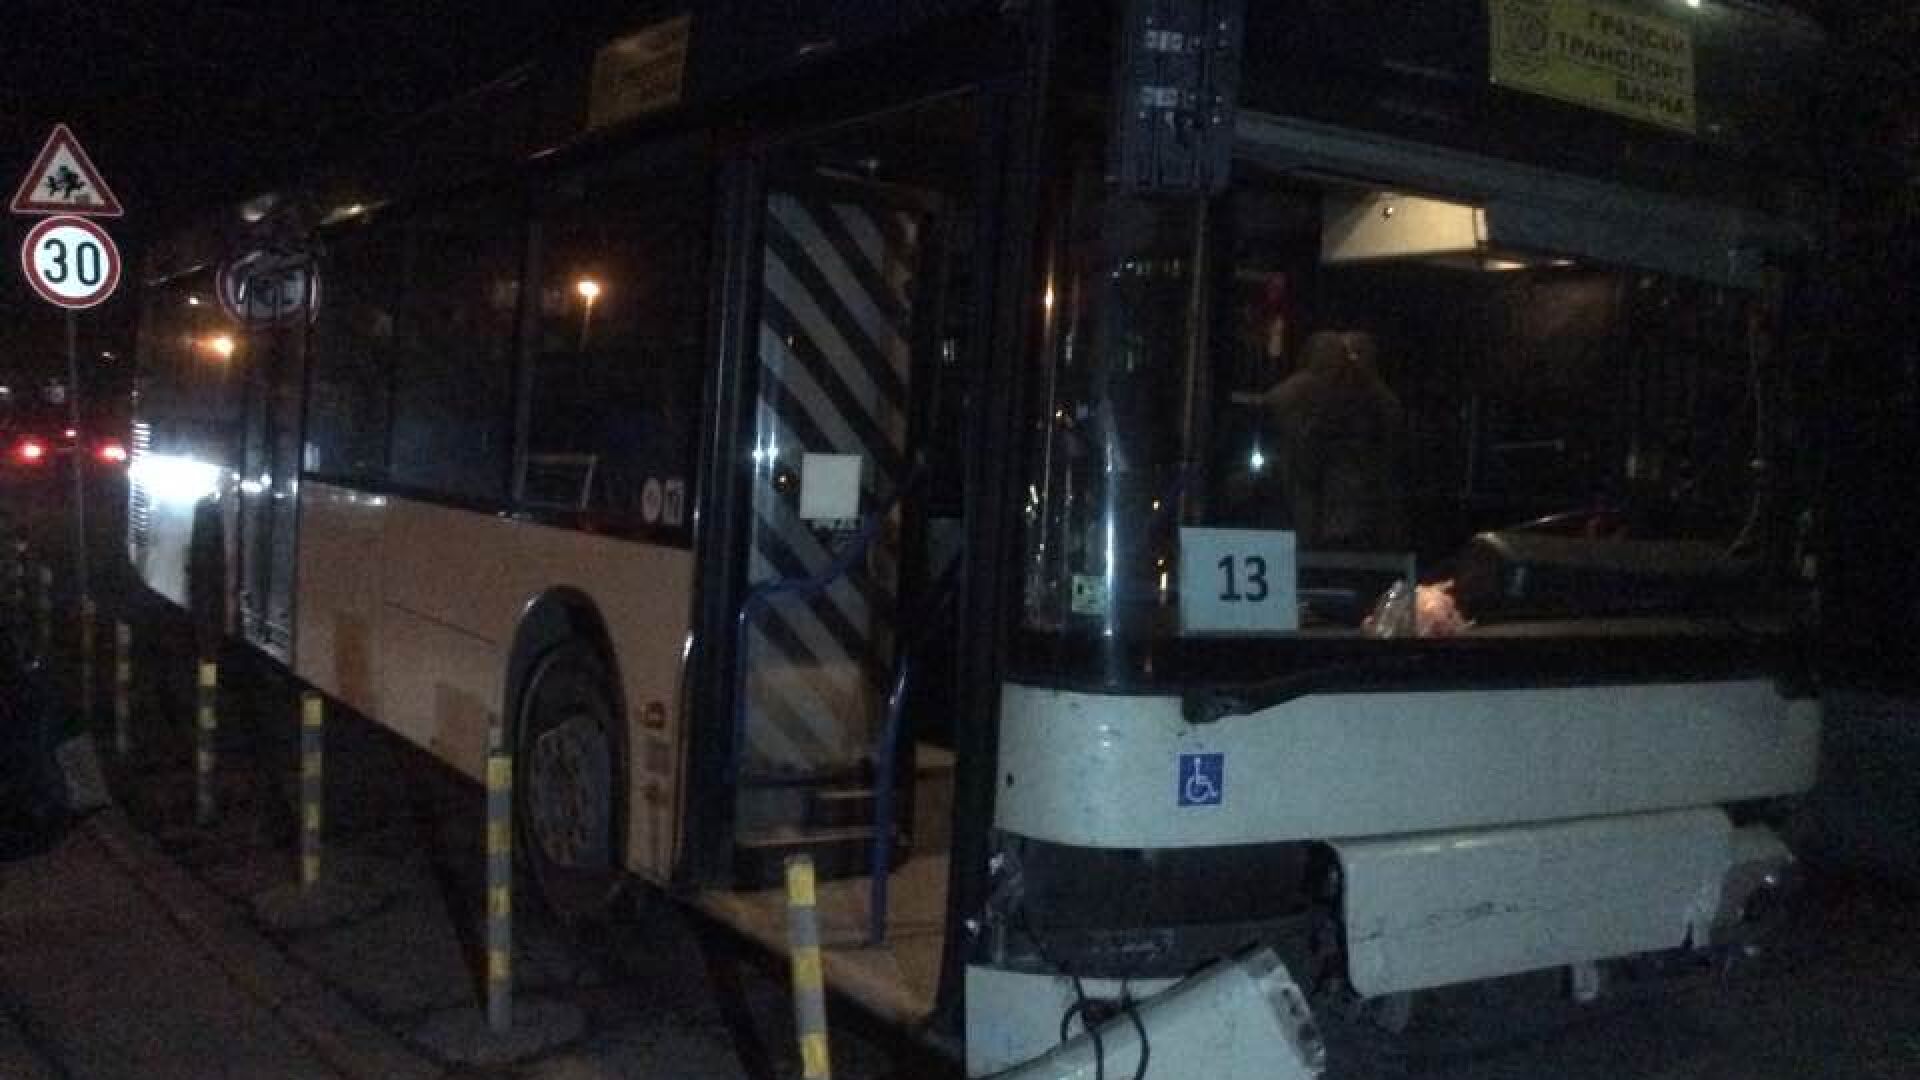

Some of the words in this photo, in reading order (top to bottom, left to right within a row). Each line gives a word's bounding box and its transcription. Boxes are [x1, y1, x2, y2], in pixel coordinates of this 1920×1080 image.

[1557, 33, 1685, 82] ТРАНСПОРТ
[1616, 79, 1685, 114] ВАРНА
[43, 238, 101, 286] 30
[1217, 554, 1268, 603] 13
